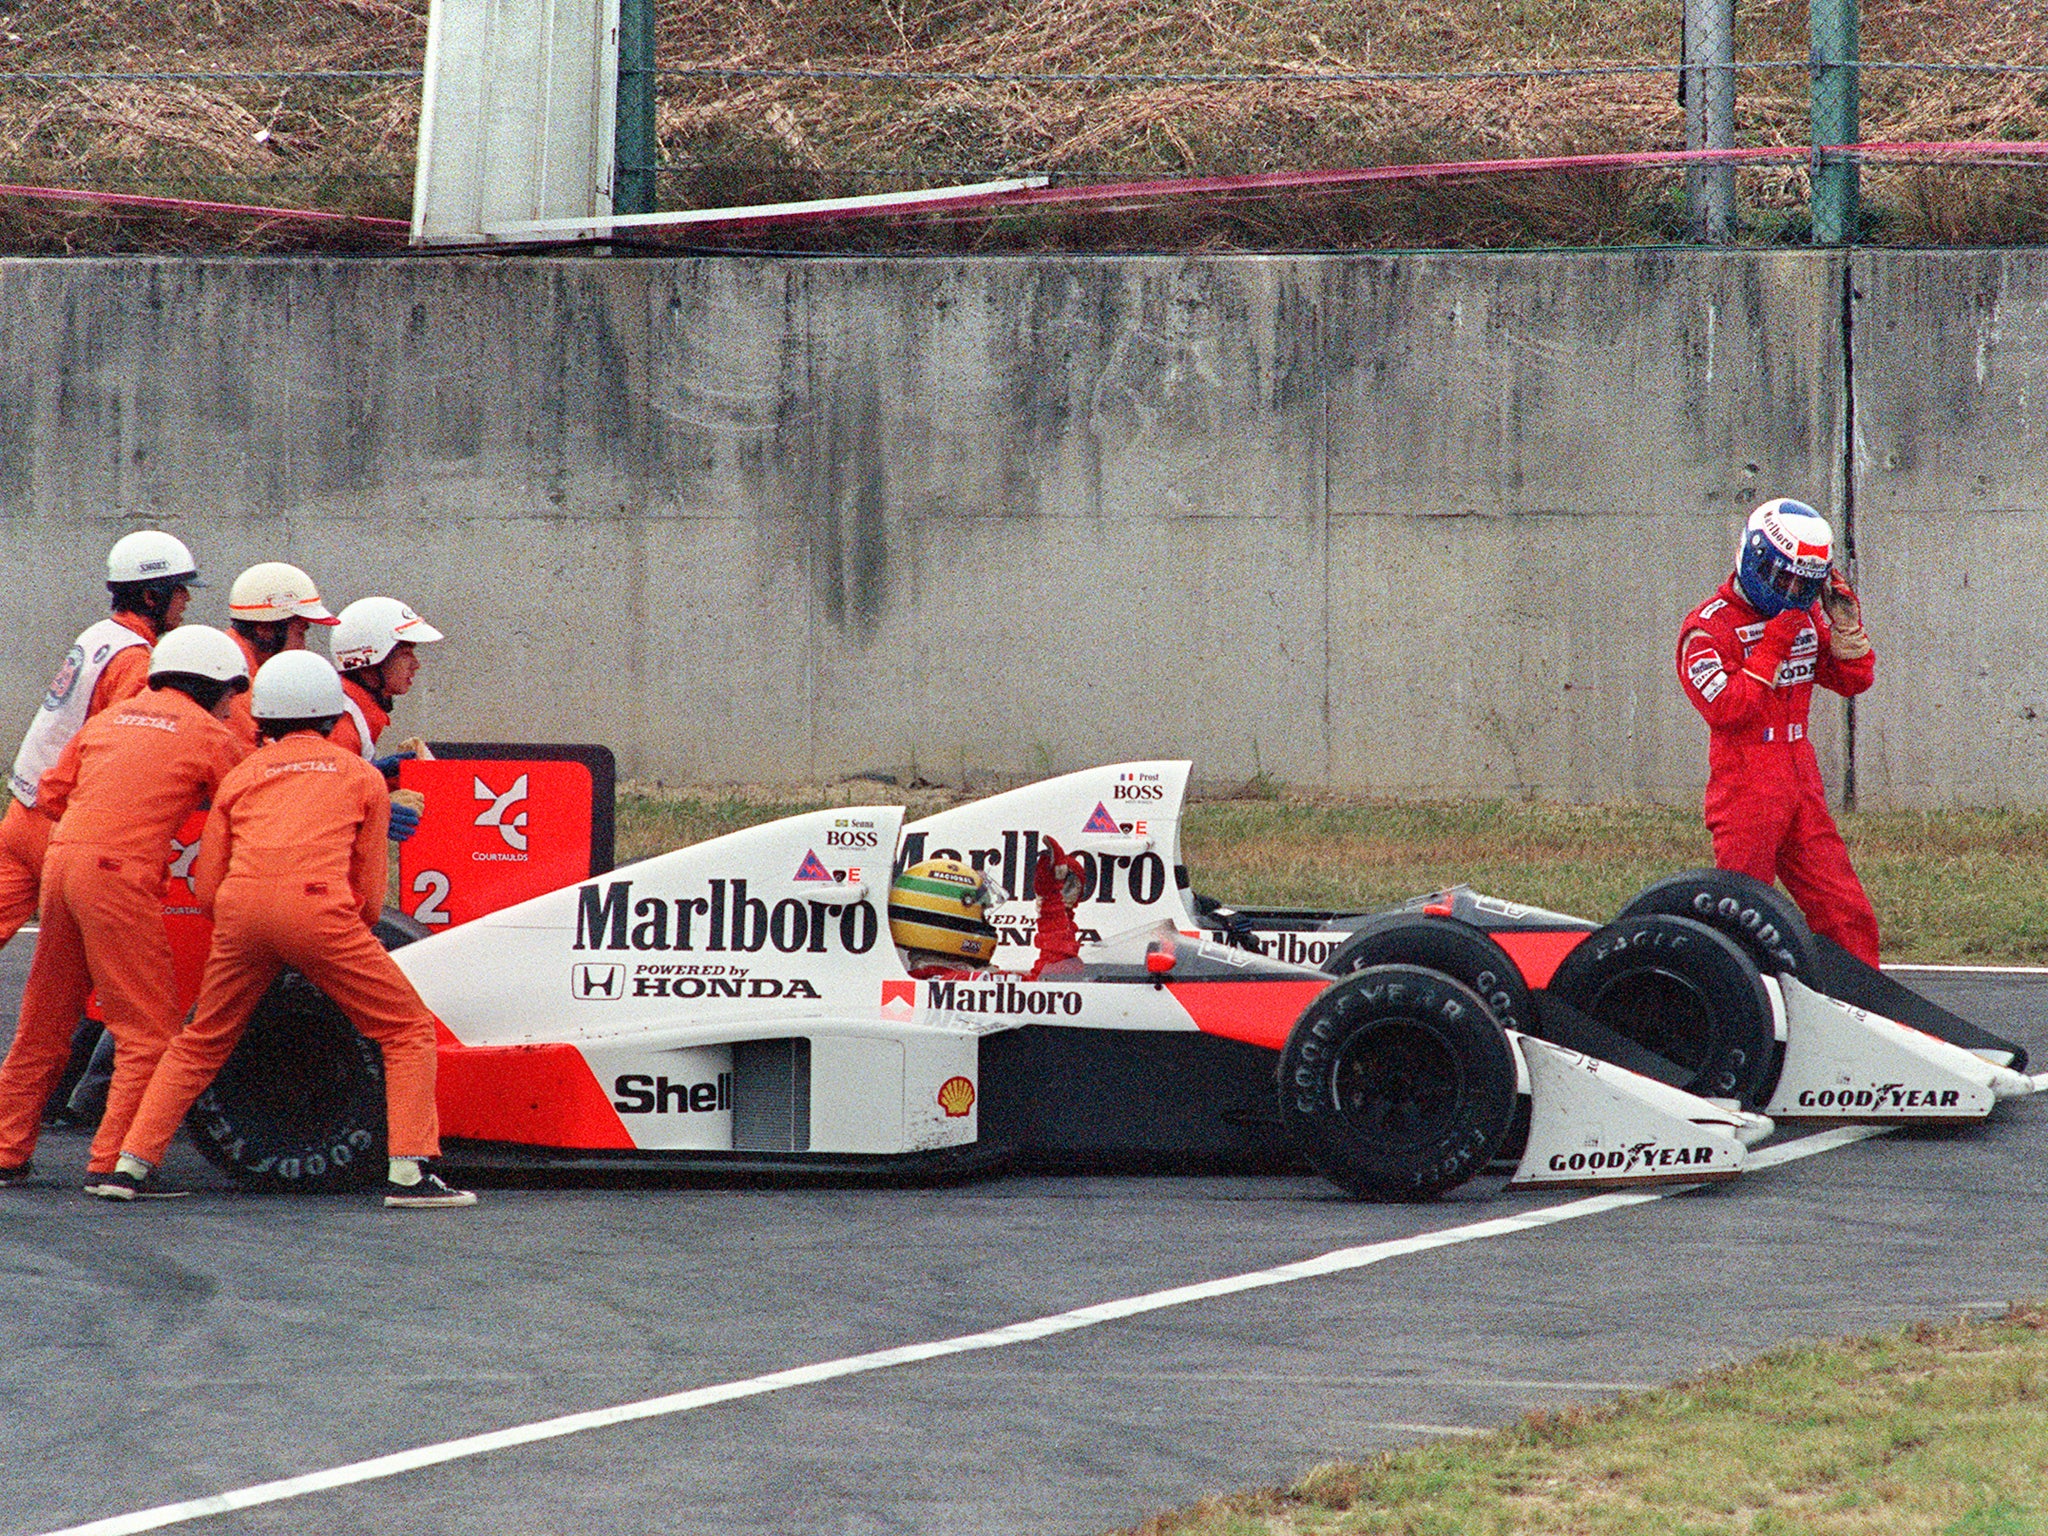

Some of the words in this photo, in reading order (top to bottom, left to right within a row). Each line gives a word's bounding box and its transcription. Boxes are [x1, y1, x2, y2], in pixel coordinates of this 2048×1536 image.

[114, 714, 177, 733] OFFICIAL
[264, 761, 337, 778] OFFICIAL
[1140, 773, 1159, 781] Prost
[1114, 785, 1163, 800] BOSS
[851, 820, 874, 828] Senna
[827, 831, 878, 847] BOSS
[413, 870, 449, 923] 2
[572, 878, 879, 954] Marlboro
[635, 964, 725, 976] POWERED
[729, 964, 750, 977] by
[632, 978, 822, 999] HONDA
[927, 981, 1082, 1015] Marlboro
[614, 1074, 732, 1114] Shell
